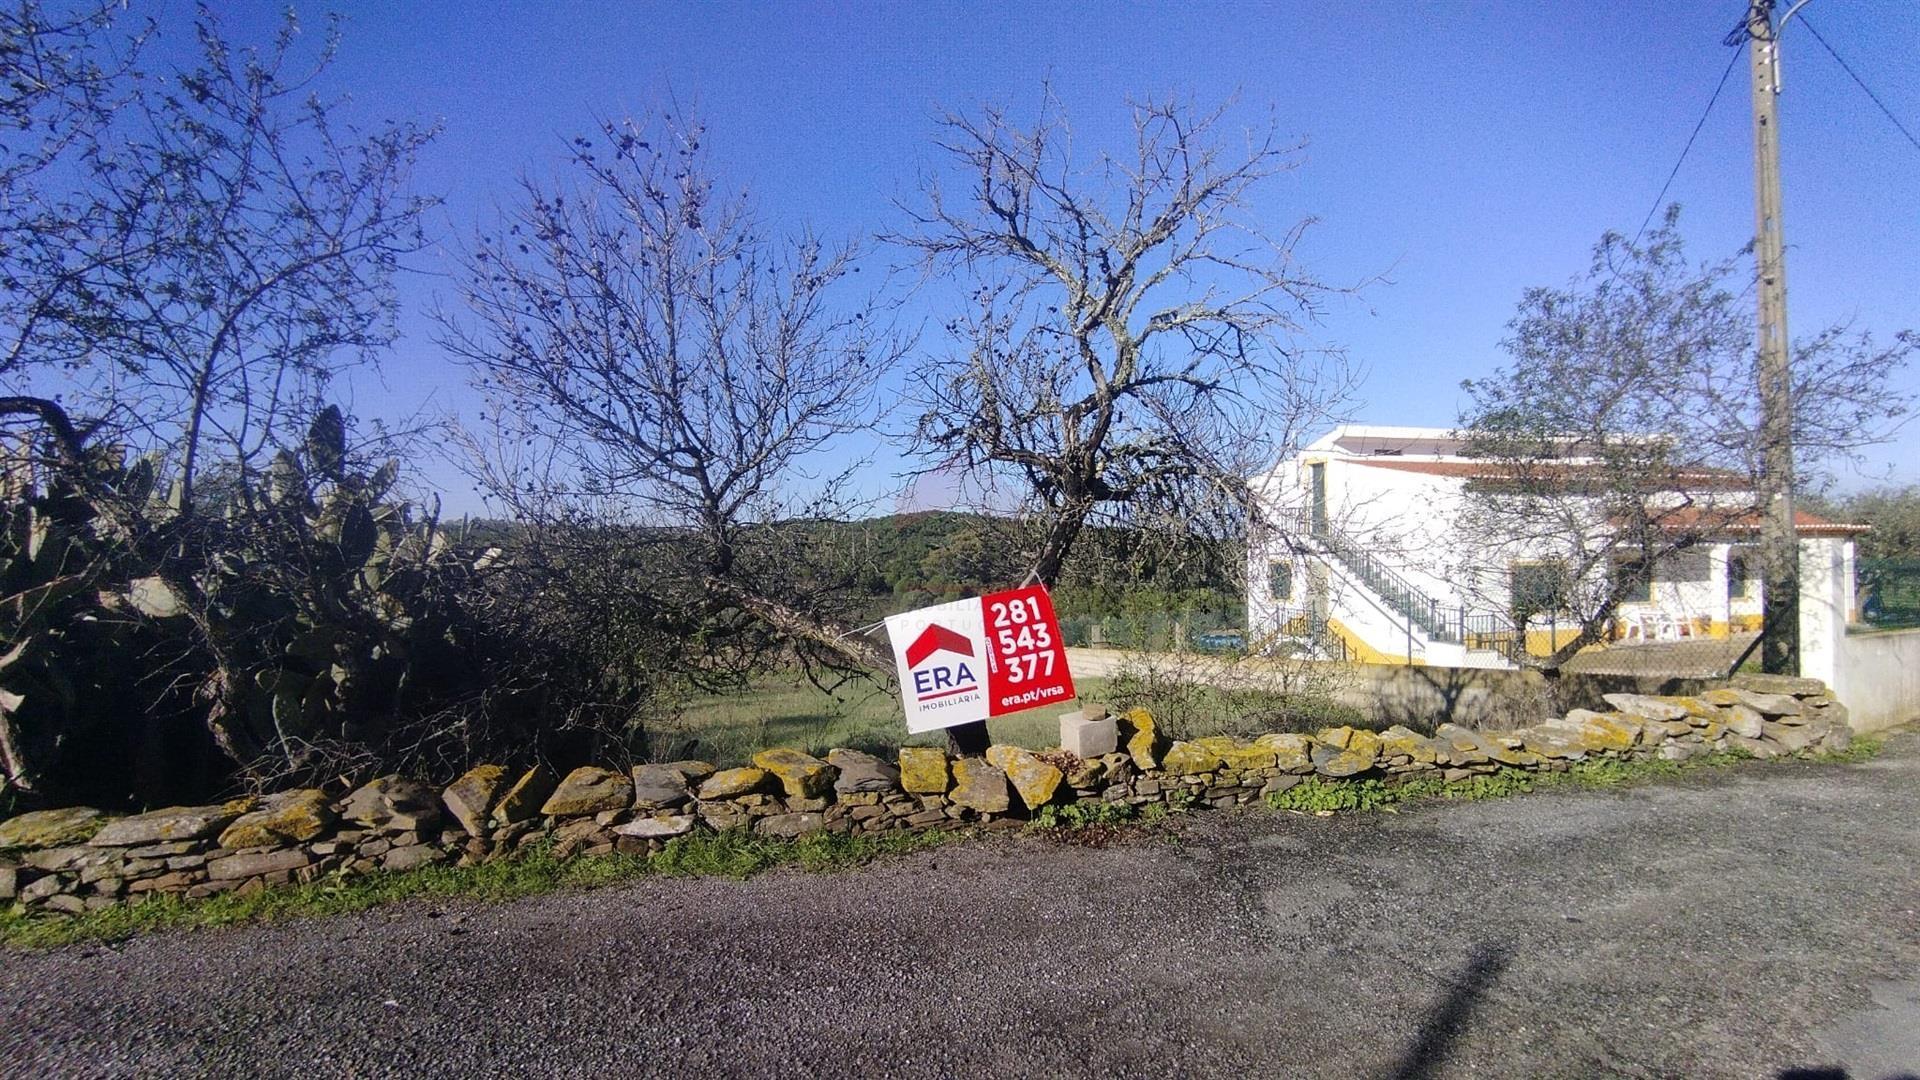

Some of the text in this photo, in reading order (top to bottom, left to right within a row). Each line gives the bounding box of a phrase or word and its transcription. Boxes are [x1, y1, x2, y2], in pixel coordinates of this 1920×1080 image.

[991, 596, 1041, 628] 281
[998, 622, 1051, 655] 543
[913, 662, 976, 693] ERA
[1004, 649, 1055, 683] 377
[1001, 685, 1064, 706] era.pt/vrsa
